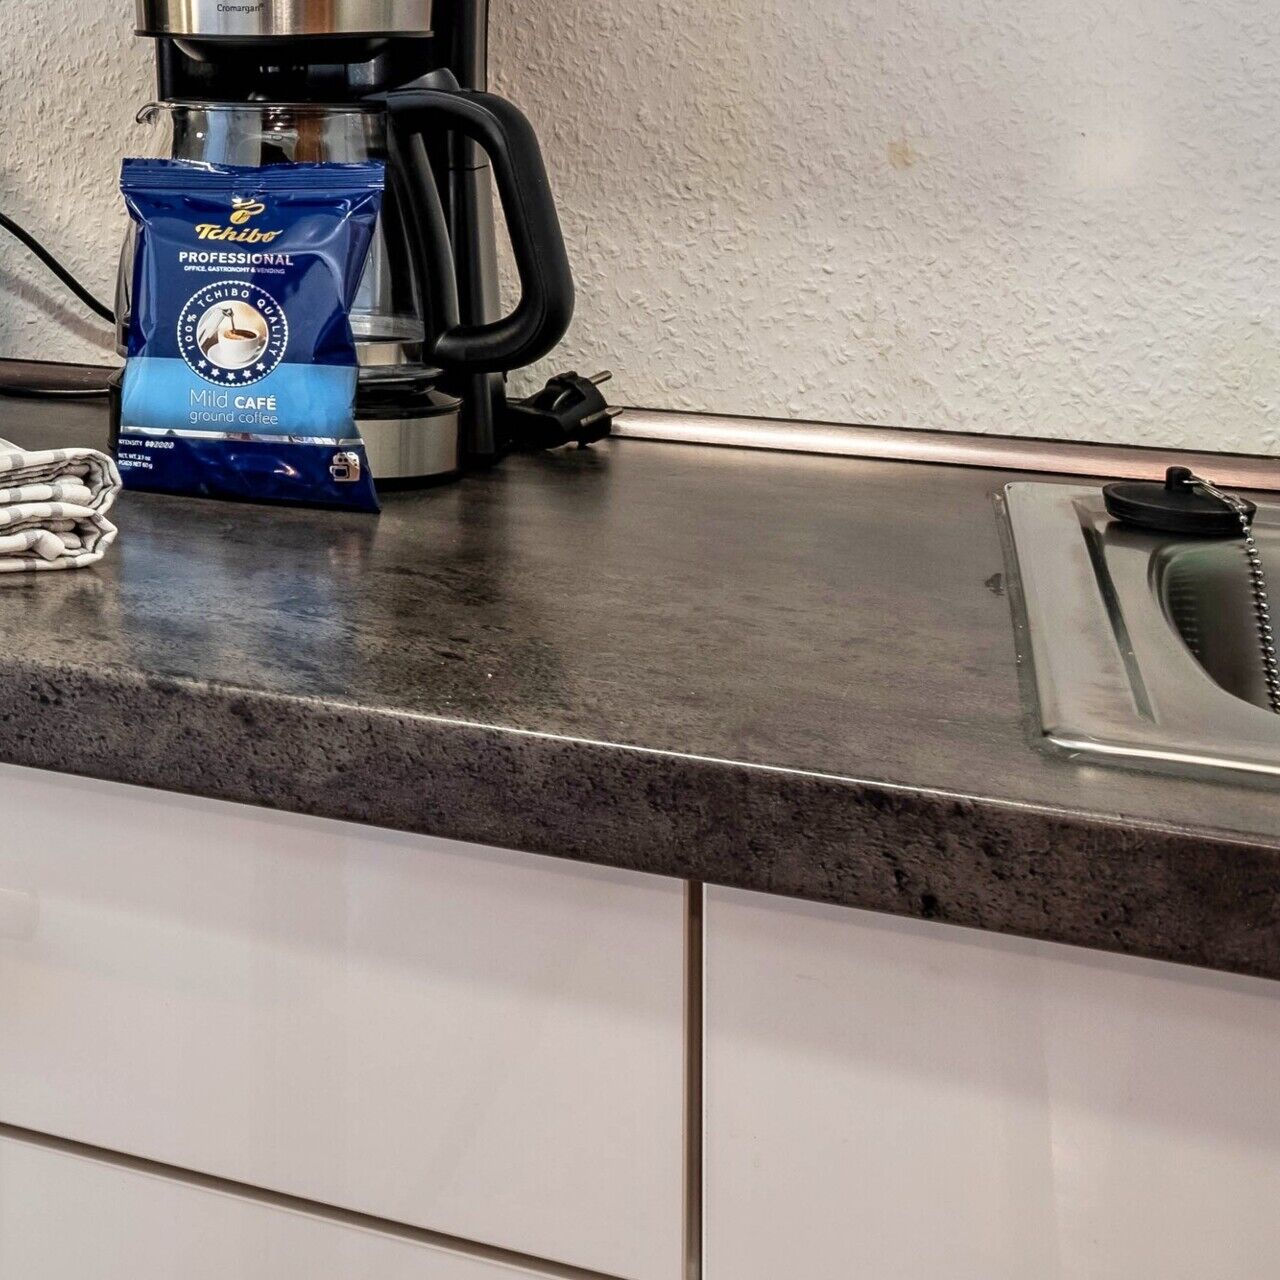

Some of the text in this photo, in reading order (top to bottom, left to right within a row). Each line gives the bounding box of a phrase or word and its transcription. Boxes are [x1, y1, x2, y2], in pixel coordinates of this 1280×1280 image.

[195, 223, 283, 243] Tchibo
[179, 251, 294, 266] PROFESSIONAL
[184, 287, 281, 356] 100% TCHIBO QUALITY
[190, 389, 277, 411] Mild CAFÉ
[189, 410, 279, 425] ground coffee
